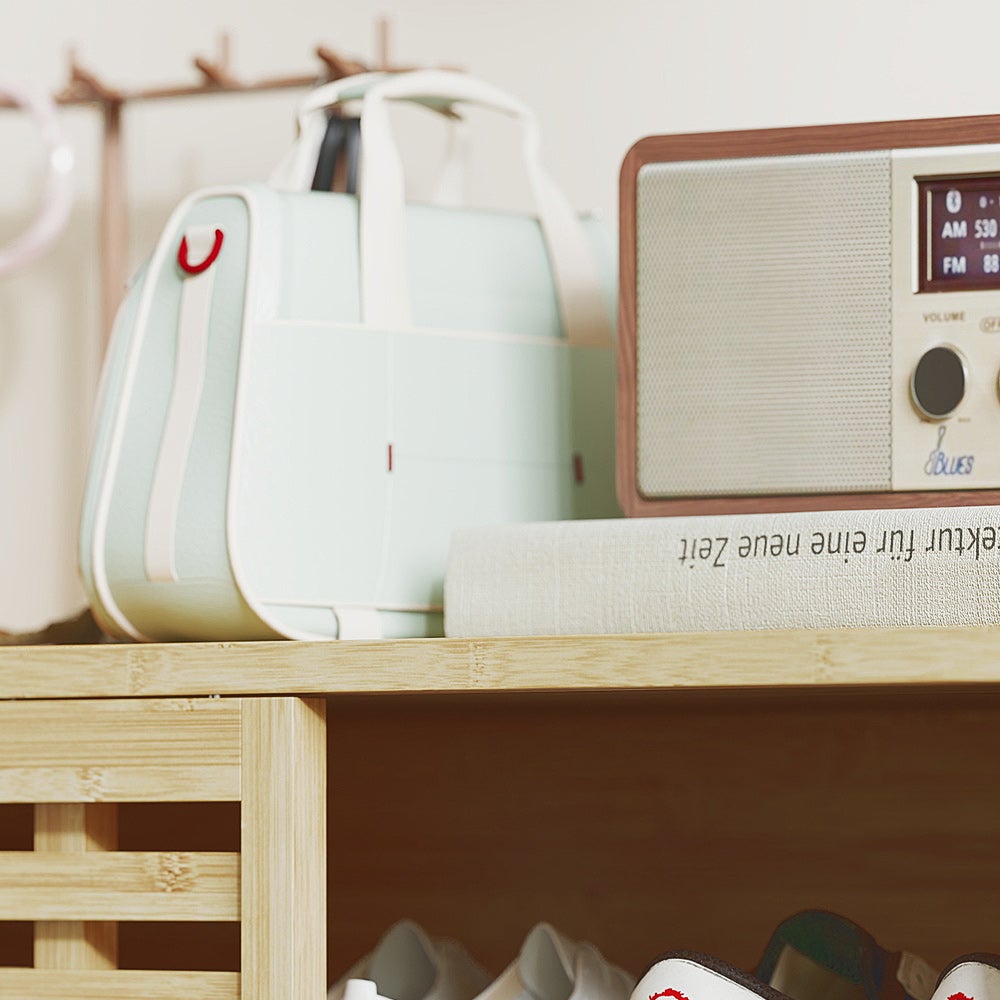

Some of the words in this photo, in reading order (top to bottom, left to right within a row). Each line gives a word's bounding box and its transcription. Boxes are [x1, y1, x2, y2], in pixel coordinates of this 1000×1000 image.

[941, 220, 968, 239] AM
[974, 218, 999, 239] 530
[942, 255, 967, 275] FM
[983, 253, 1000, 274] 88
[922, 312, 966, 323] VOLUME
[678, 537, 729, 569] Zeit
[738, 533, 800, 558] neue
[811, 530, 867, 564] eine
[876, 529, 915, 562] für
